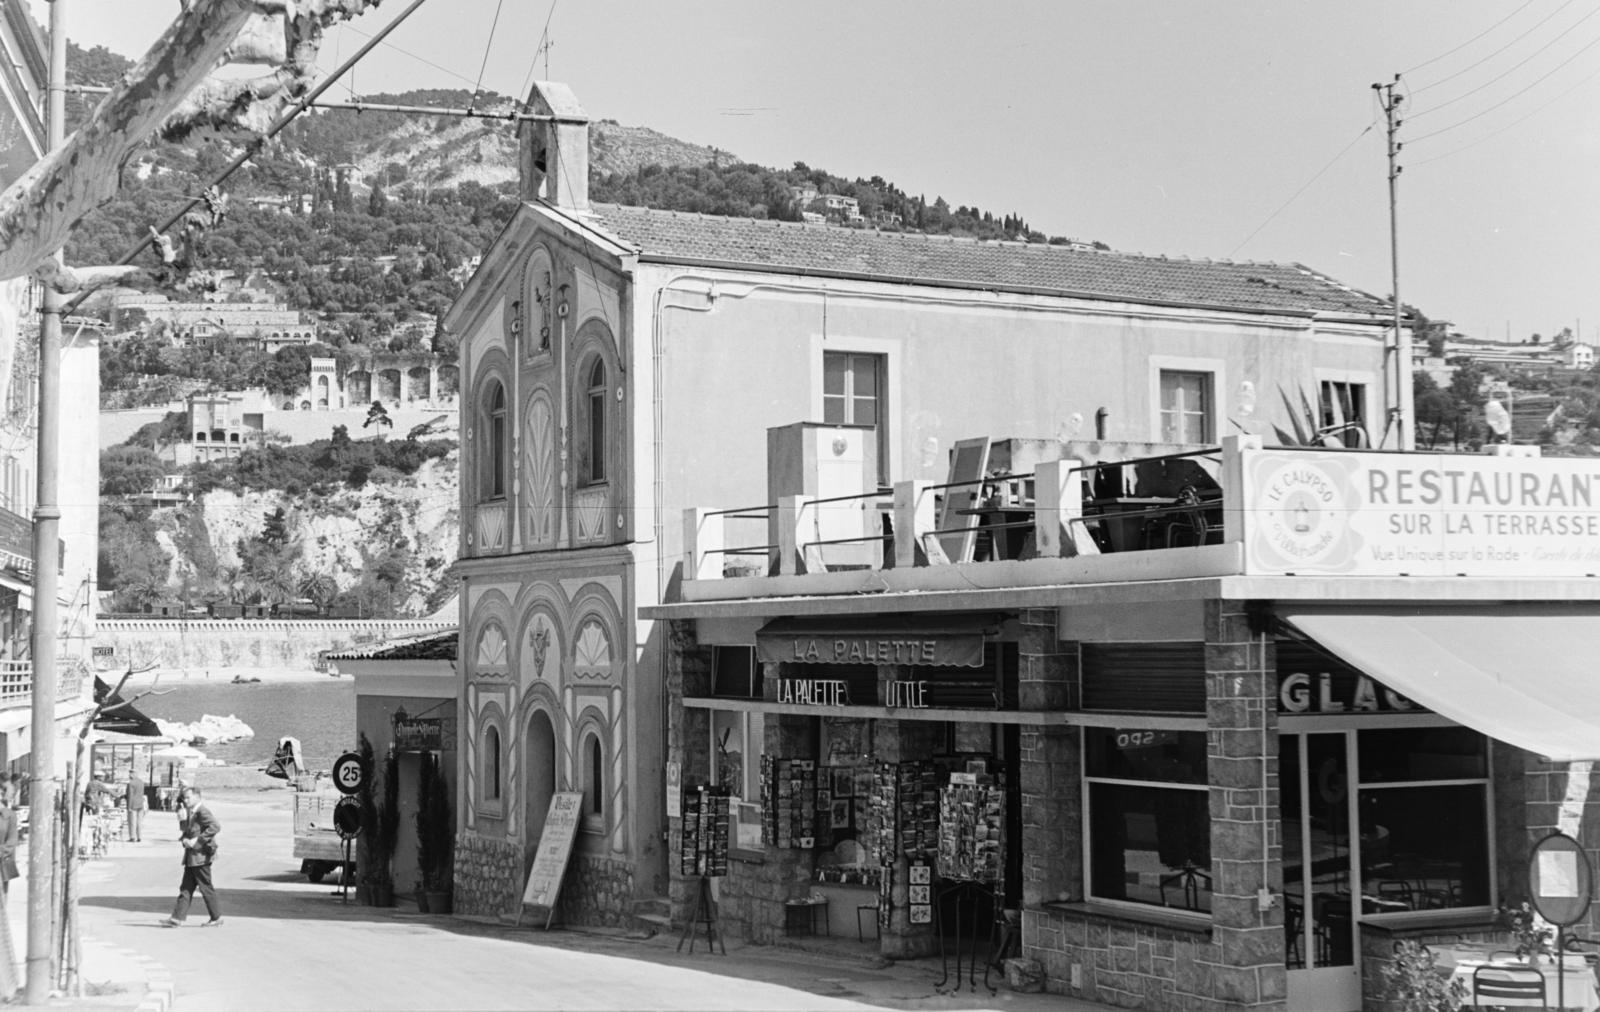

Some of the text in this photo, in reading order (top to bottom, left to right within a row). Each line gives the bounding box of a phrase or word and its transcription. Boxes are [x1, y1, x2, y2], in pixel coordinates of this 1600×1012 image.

[1268, 469, 1335, 503] LE CALYPSO
[1389, 513, 1598, 536] SUR LA TERRASSE
[1371, 545, 1394, 561] Vue
[1397, 545, 1444, 564] Unique
[1448, 551, 1469, 561] sur
[1471, 546, 1484, 561] la
[1487, 545, 1521, 561] Rade
[794, 640, 937, 663] LA PALETTE
[777, 678, 793, 704] LA
[795, 679, 845, 707] PALETTE
[343, 766, 359, 782] 25
